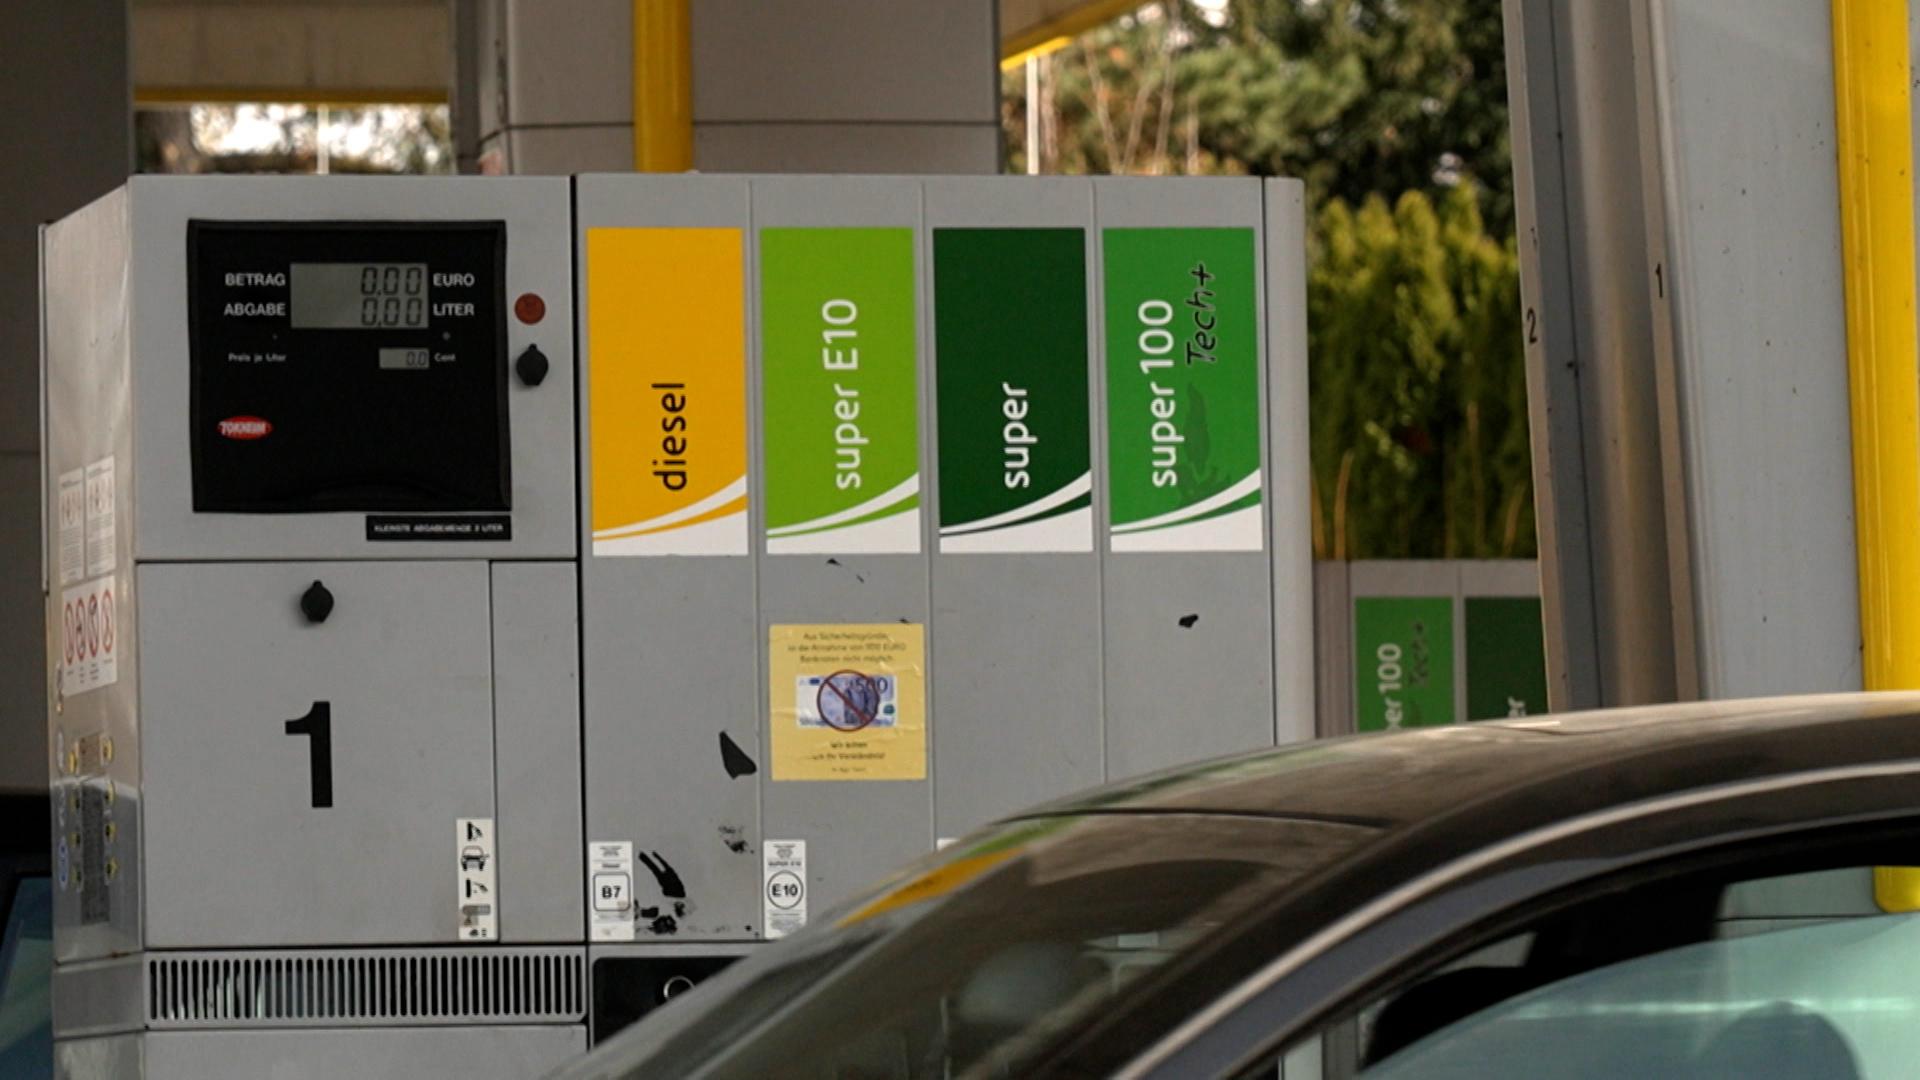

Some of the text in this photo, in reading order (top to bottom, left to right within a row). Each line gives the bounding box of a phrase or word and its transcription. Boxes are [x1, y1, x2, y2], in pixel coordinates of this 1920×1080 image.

[224, 272, 286, 287] BETRAG
[432, 272, 475, 288] EURO
[1655, 263, 1663, 299] 1
[223, 302, 286, 316] ABGABE
[433, 302, 475, 317] LITER
[1185, 263, 1216, 366] Tech+
[1526, 307, 1538, 345] 2
[821, 298, 870, 490] super E10
[1138, 299, 1185, 488] super 100
[651, 383, 688, 492] diesel
[1002, 382, 1038, 489] super
[1377, 643, 1402, 694] 100
[285, 701, 333, 808] 1
[601, 885, 621, 899] B7
[771, 883, 799, 898] E10
